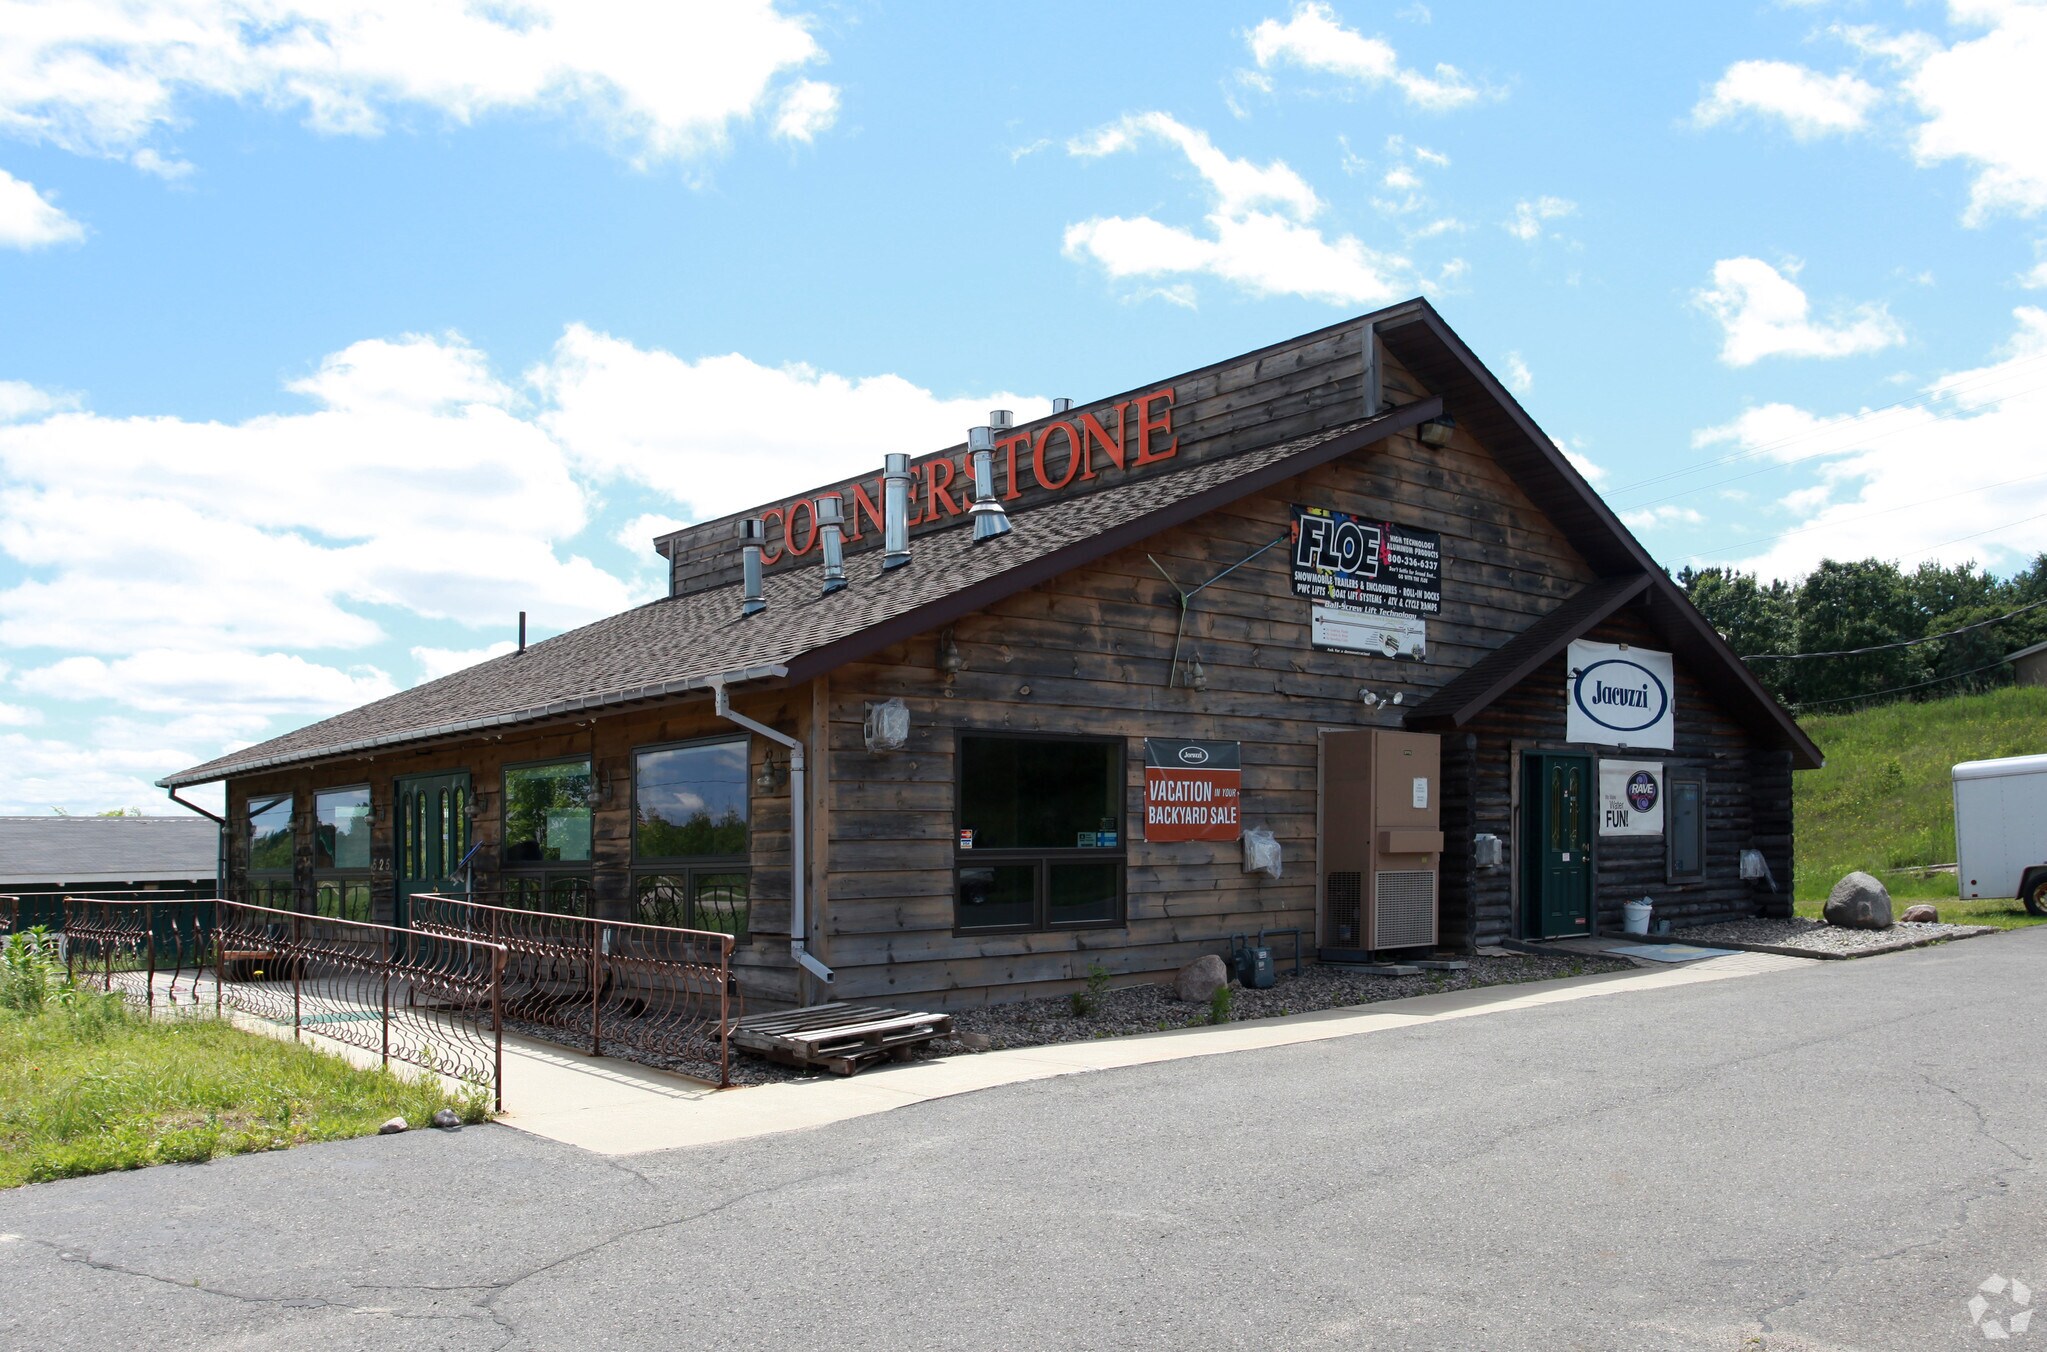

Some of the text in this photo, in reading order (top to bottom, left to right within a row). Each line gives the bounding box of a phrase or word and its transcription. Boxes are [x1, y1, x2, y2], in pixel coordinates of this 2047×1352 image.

[1297, 515, 1381, 577] FLOE
[1387, 543, 1438, 558] ALUMINUM PRODUCTS
[1390, 535, 1434, 550] HIGH TECHNOLOGY
[1388, 554, 1438, 570] 800-336-6337
[1294, 571, 1440, 601] SNOWMOBILE TRAILERS & ENCLOSURES ROLL-IN DOCKS
[1297, 583, 1438, 612] PWC LIFTS BOAT LIFT SYSTEMS ATV & CYCLE RAMPS
[1324, 600, 1364, 612] Ball-Screw
[1365, 606, 1377, 614] Lift
[1379, 608, 1417, 620] Technology
[1592, 680, 1648, 708] Jacuzzi
[1150, 780, 1236, 802] VACATION IN YOUR
[1632, 784, 1654, 794] RAVE
[1609, 800, 1624, 810] Water
[1149, 806, 1236, 824] BACKYARD SALE
[1606, 810, 1628, 828] FUN!
